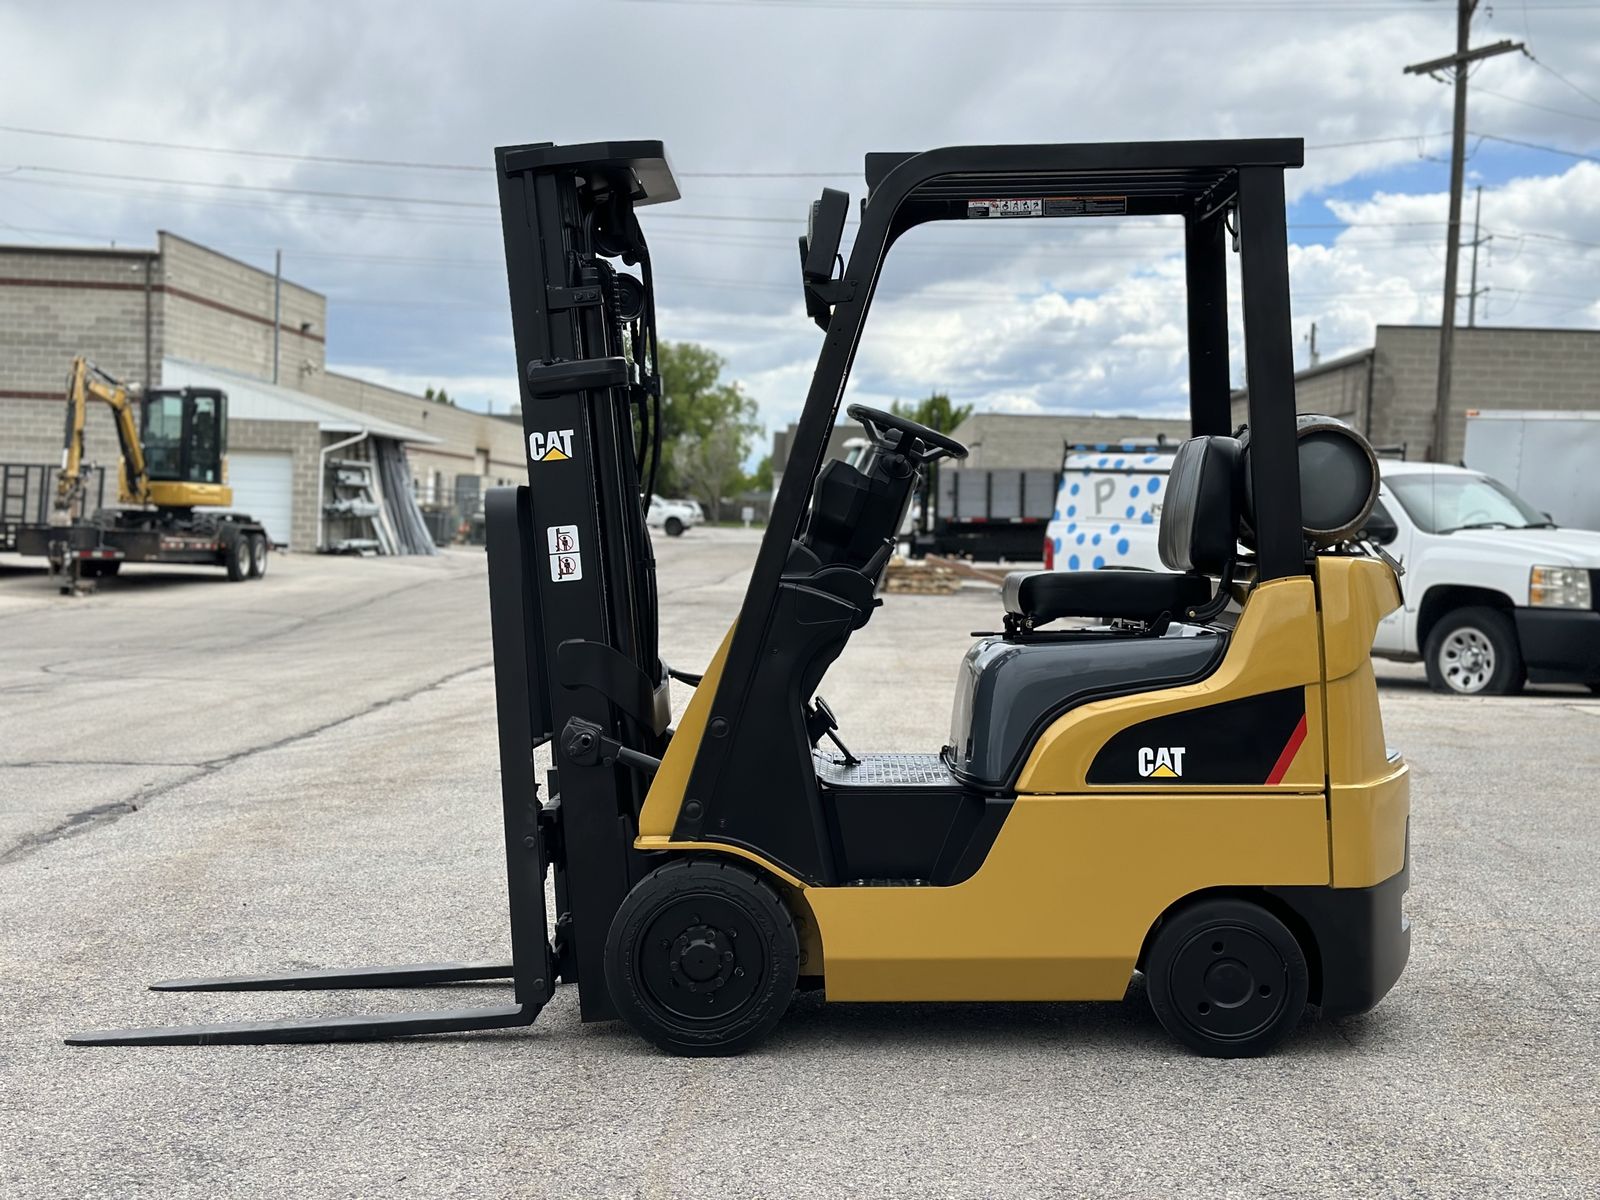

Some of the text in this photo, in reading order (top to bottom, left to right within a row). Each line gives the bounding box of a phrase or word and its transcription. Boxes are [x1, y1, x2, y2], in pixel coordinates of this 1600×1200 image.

[529, 429, 574, 461] CAT
[1094, 477, 1116, 515] P
[1138, 747, 1186, 777] CAT
